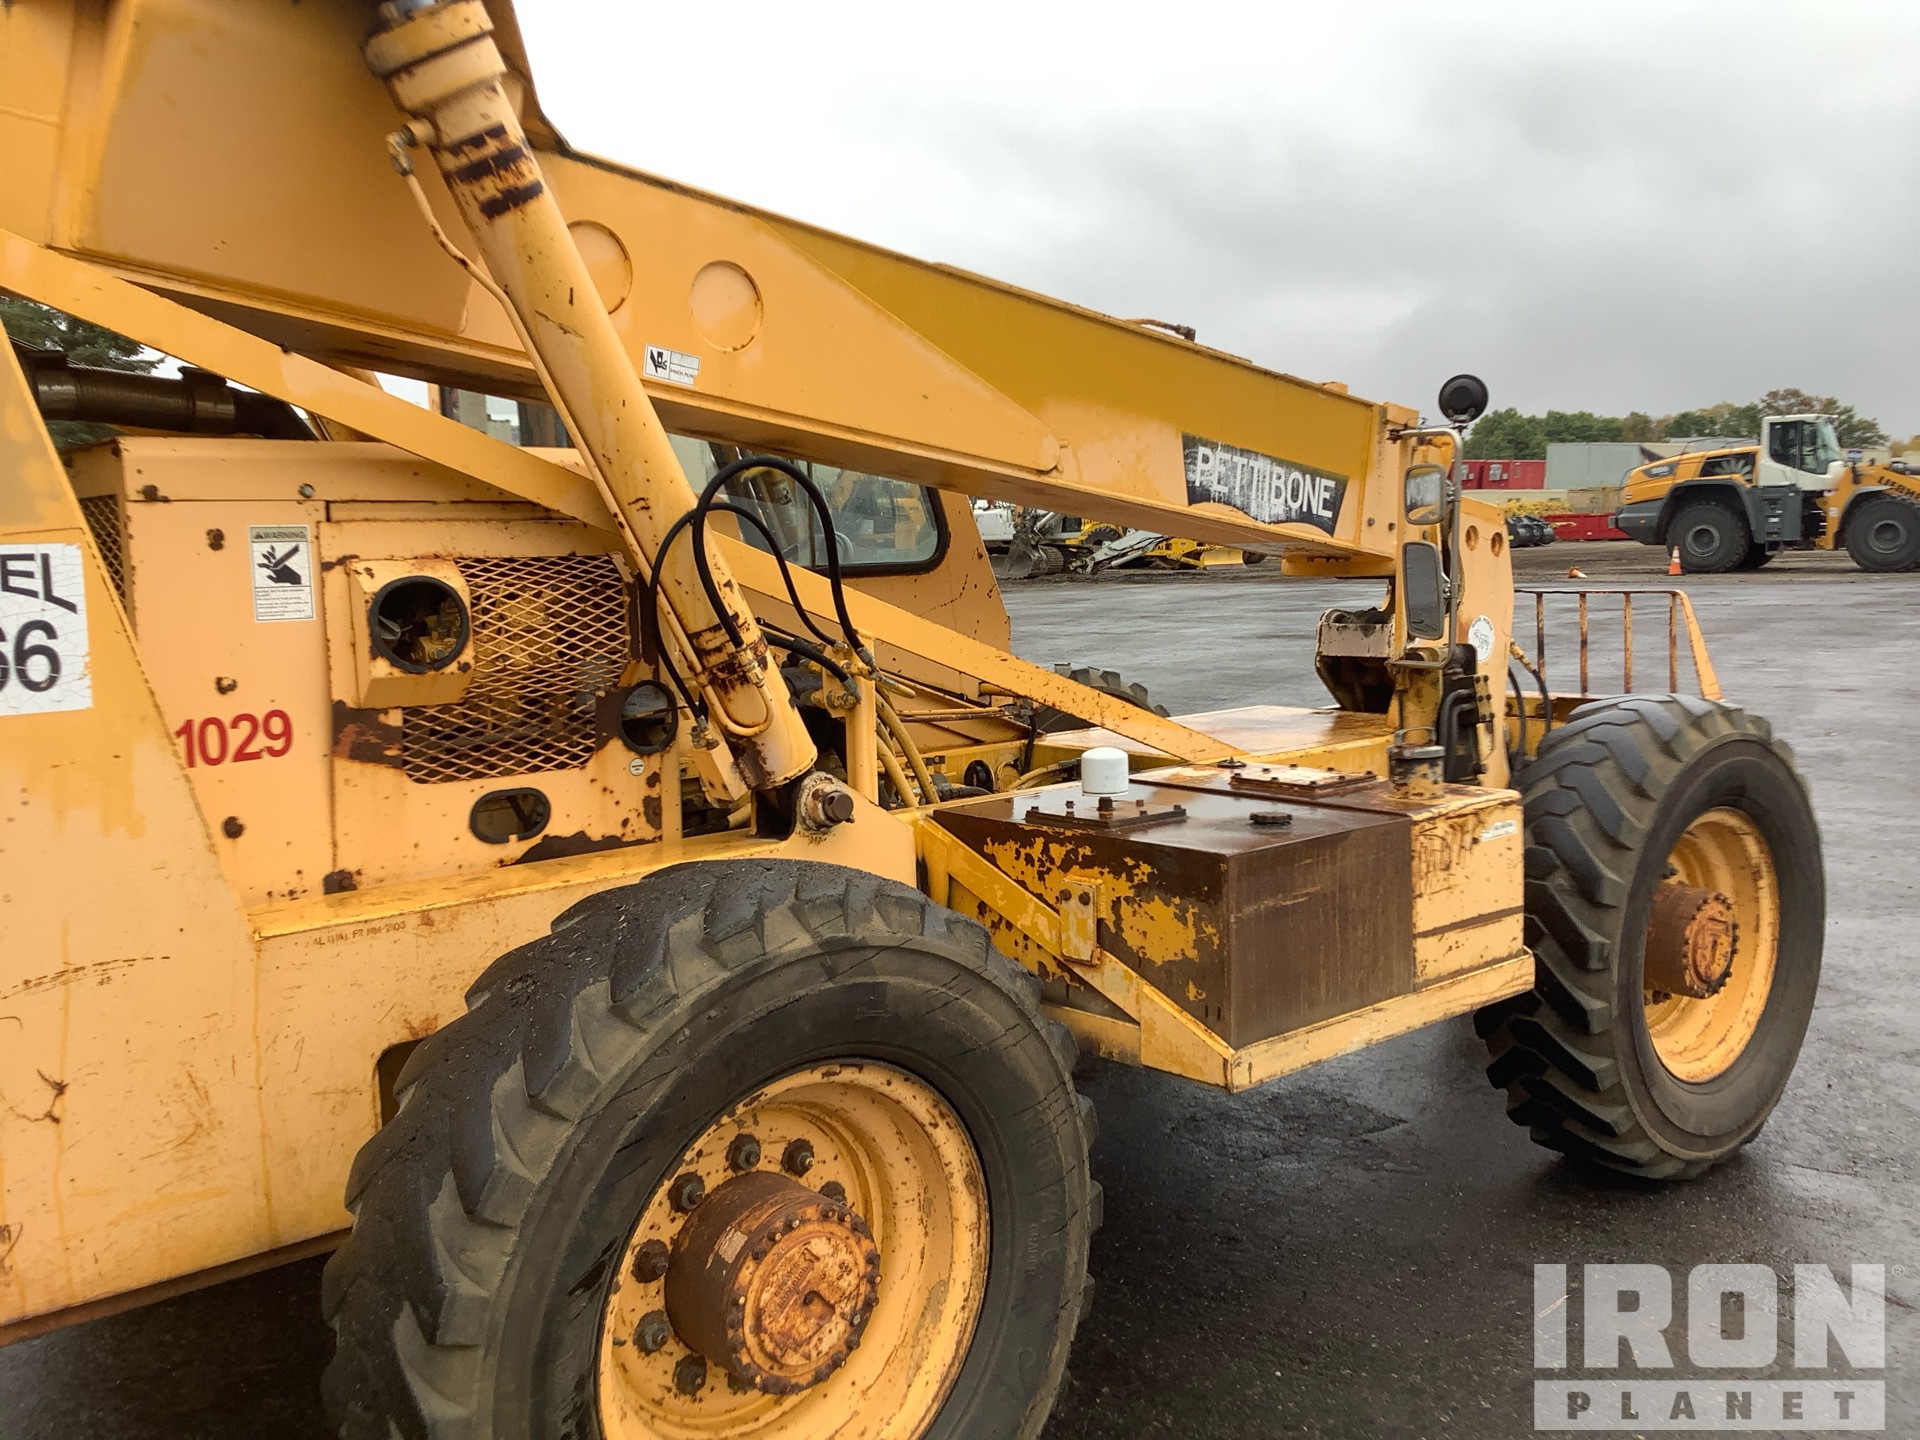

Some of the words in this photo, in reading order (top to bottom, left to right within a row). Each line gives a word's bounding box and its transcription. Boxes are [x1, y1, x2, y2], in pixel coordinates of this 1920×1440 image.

[1195, 446, 1336, 518] PETTIBONE
[262, 530, 307, 539] WARNING
[1, 553, 77, 614] EL
[0, 620, 60, 692] 6
[175, 709, 294, 768] 1029
